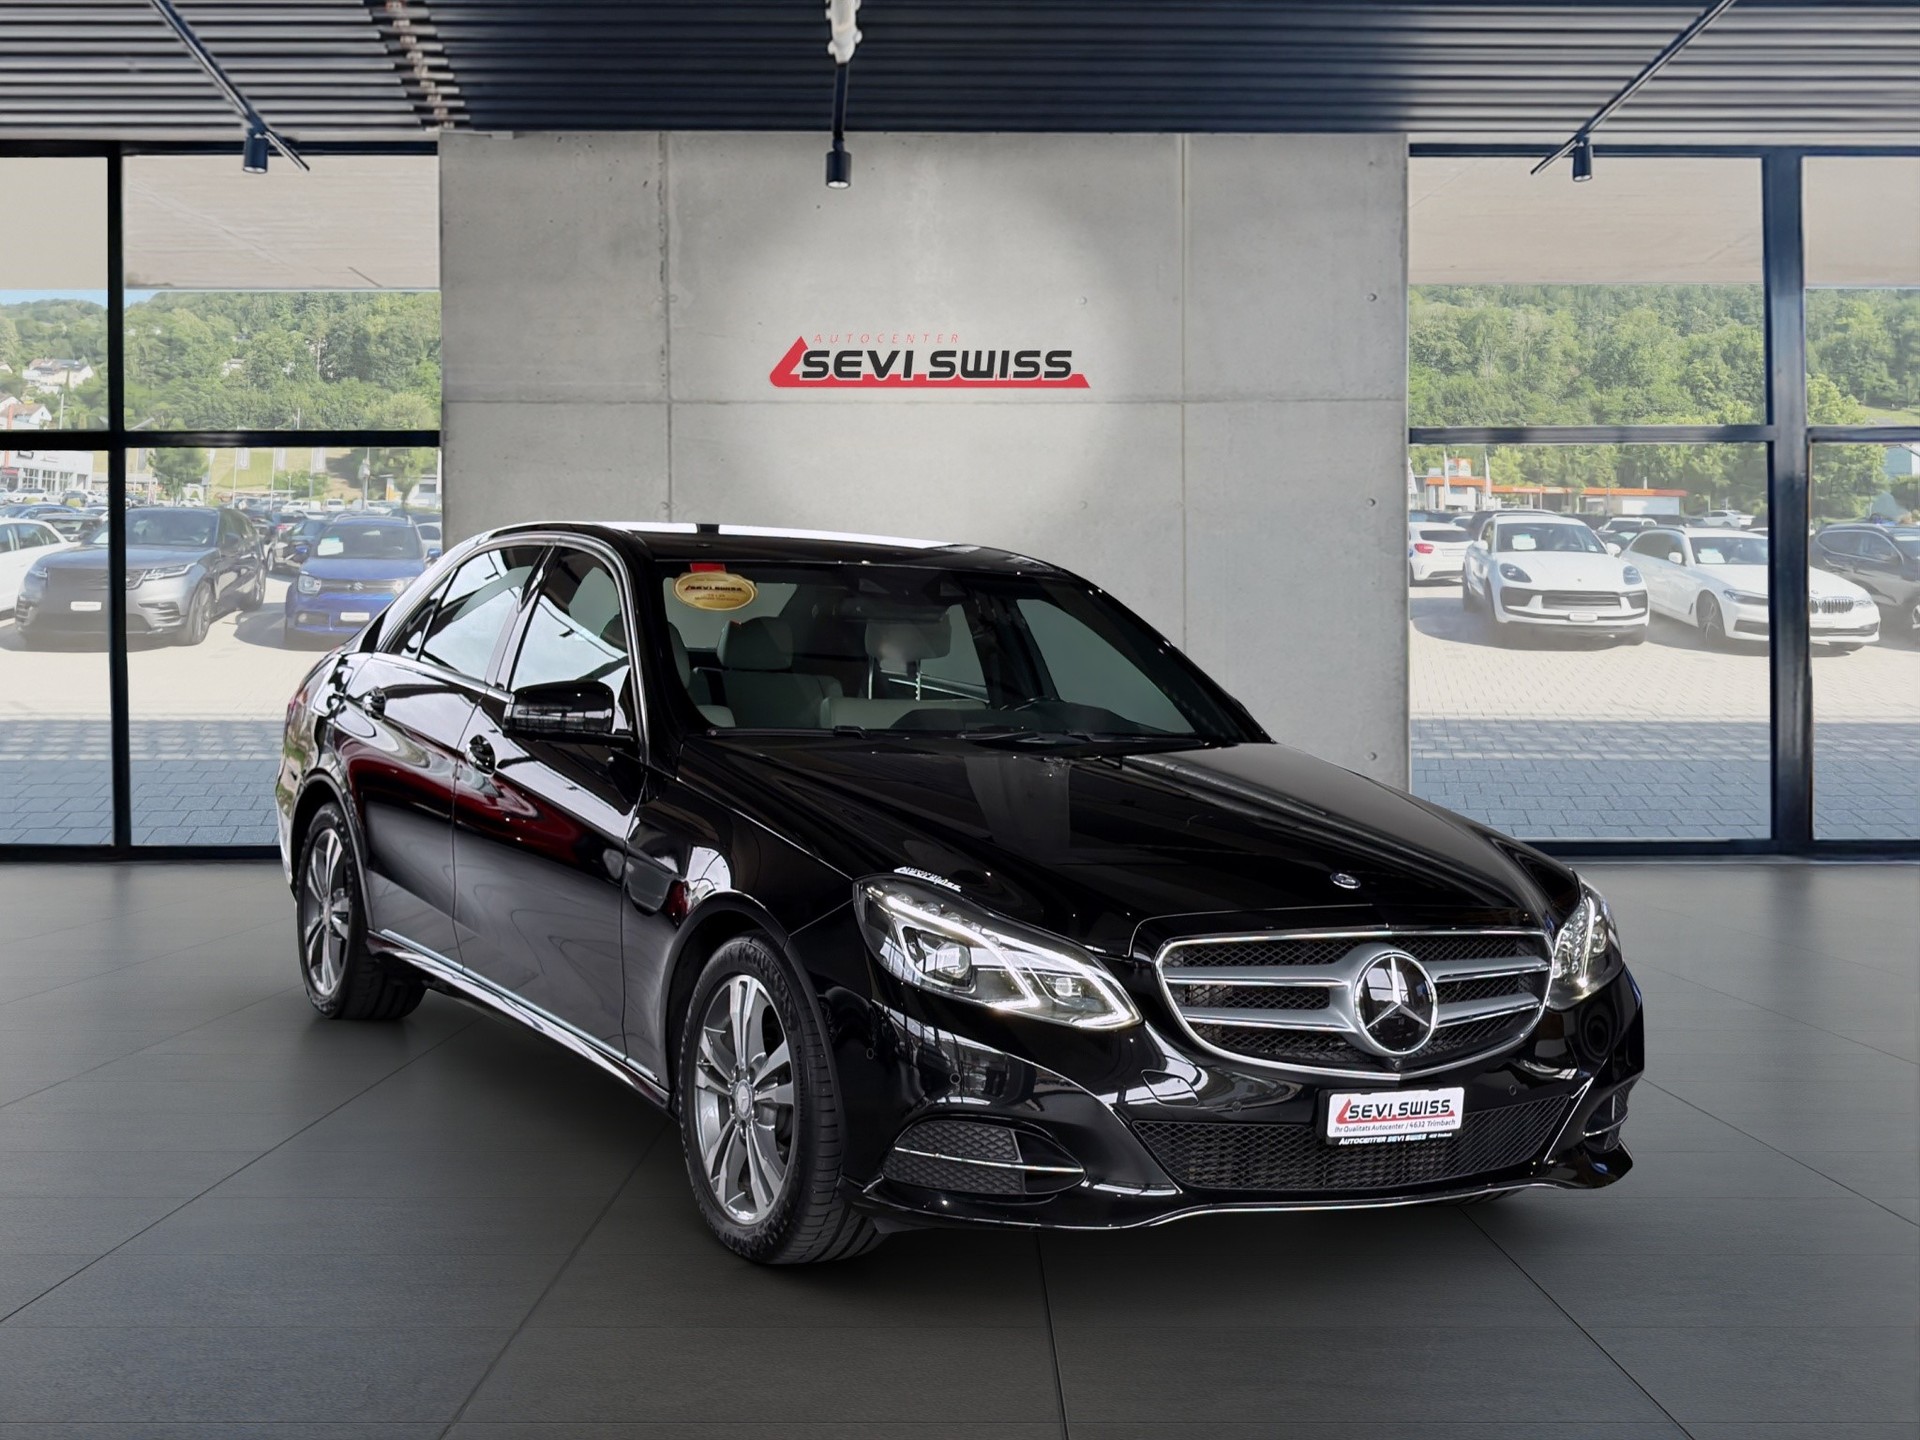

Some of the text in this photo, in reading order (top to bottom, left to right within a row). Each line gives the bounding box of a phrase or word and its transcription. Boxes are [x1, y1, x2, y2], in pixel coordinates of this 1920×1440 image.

[814, 334, 960, 344] AUTOCENTER
[802, 350, 1072, 378] SEVI SWISS
[1348, 1099, 1451, 1119] SEVI SWISS
[1371, 1123, 1404, 1131] Autocenter
[1409, 1121, 1425, 1129] 4632
[1427, 1119, 1456, 1127] Trimbach
